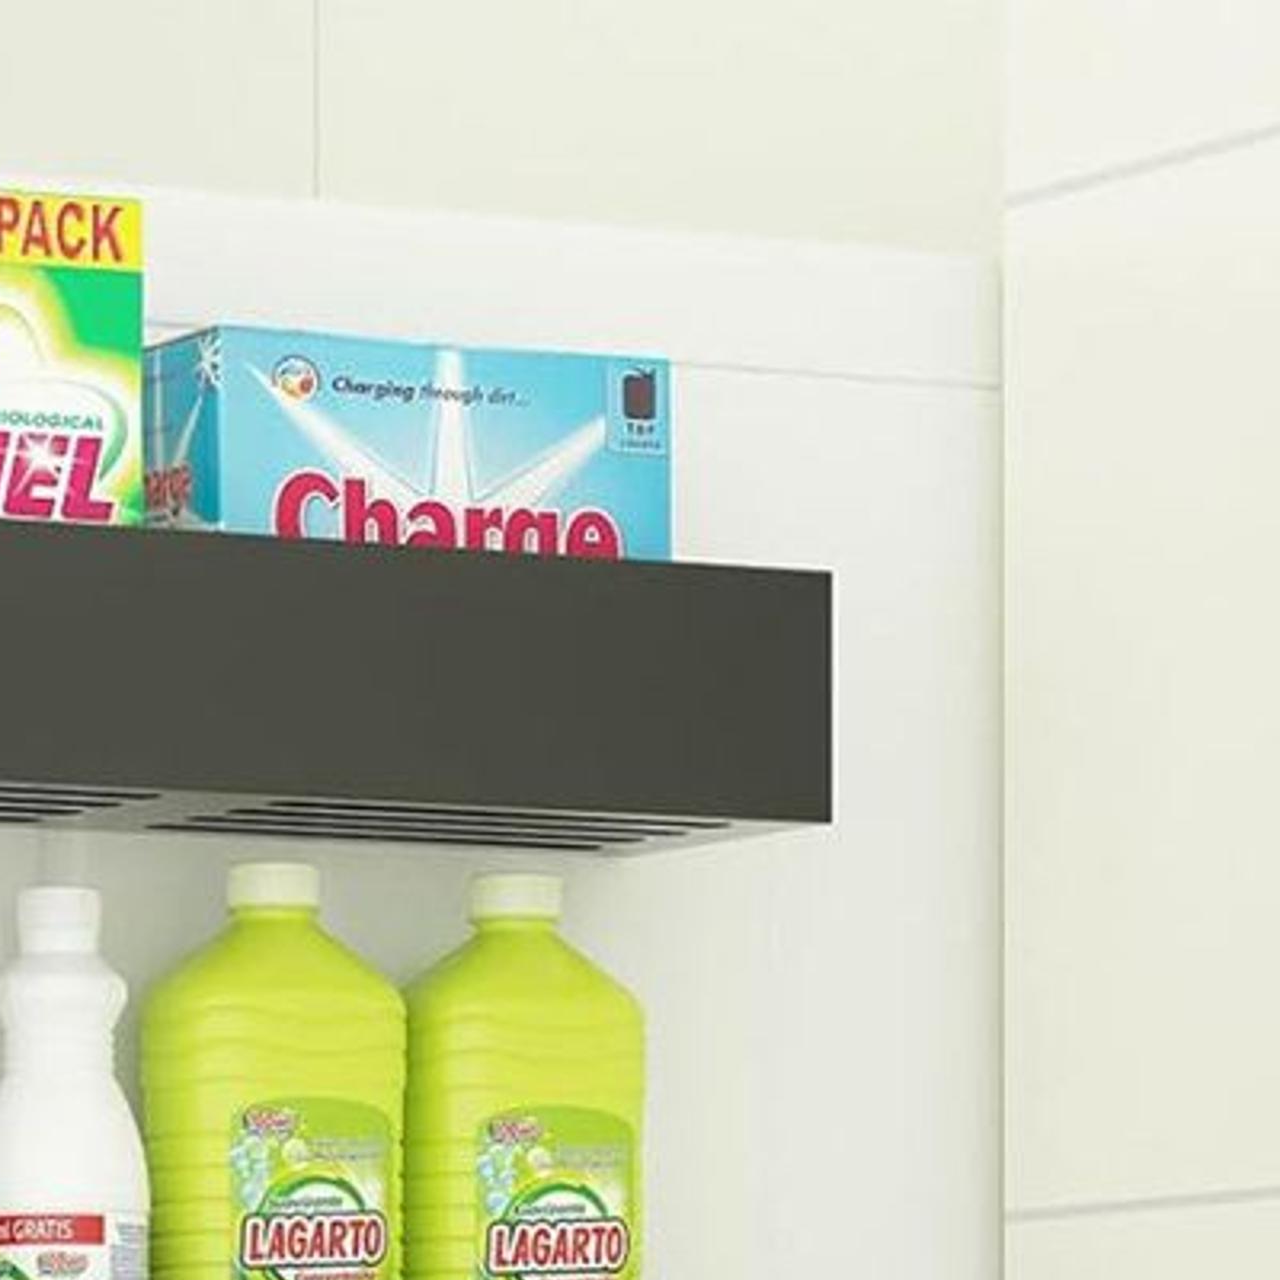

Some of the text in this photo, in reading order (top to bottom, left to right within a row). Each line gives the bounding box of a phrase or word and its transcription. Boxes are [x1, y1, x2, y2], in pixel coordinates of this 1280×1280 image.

[332, 376, 416, 403] Charging
[419, 382, 485, 405] through
[277, 472, 618, 558] Charge
[12, 1218, 75, 1241] GRATIS
[249, 1218, 382, 1262] LAGARTO
[494, 1225, 623, 1268] LAGARTO
